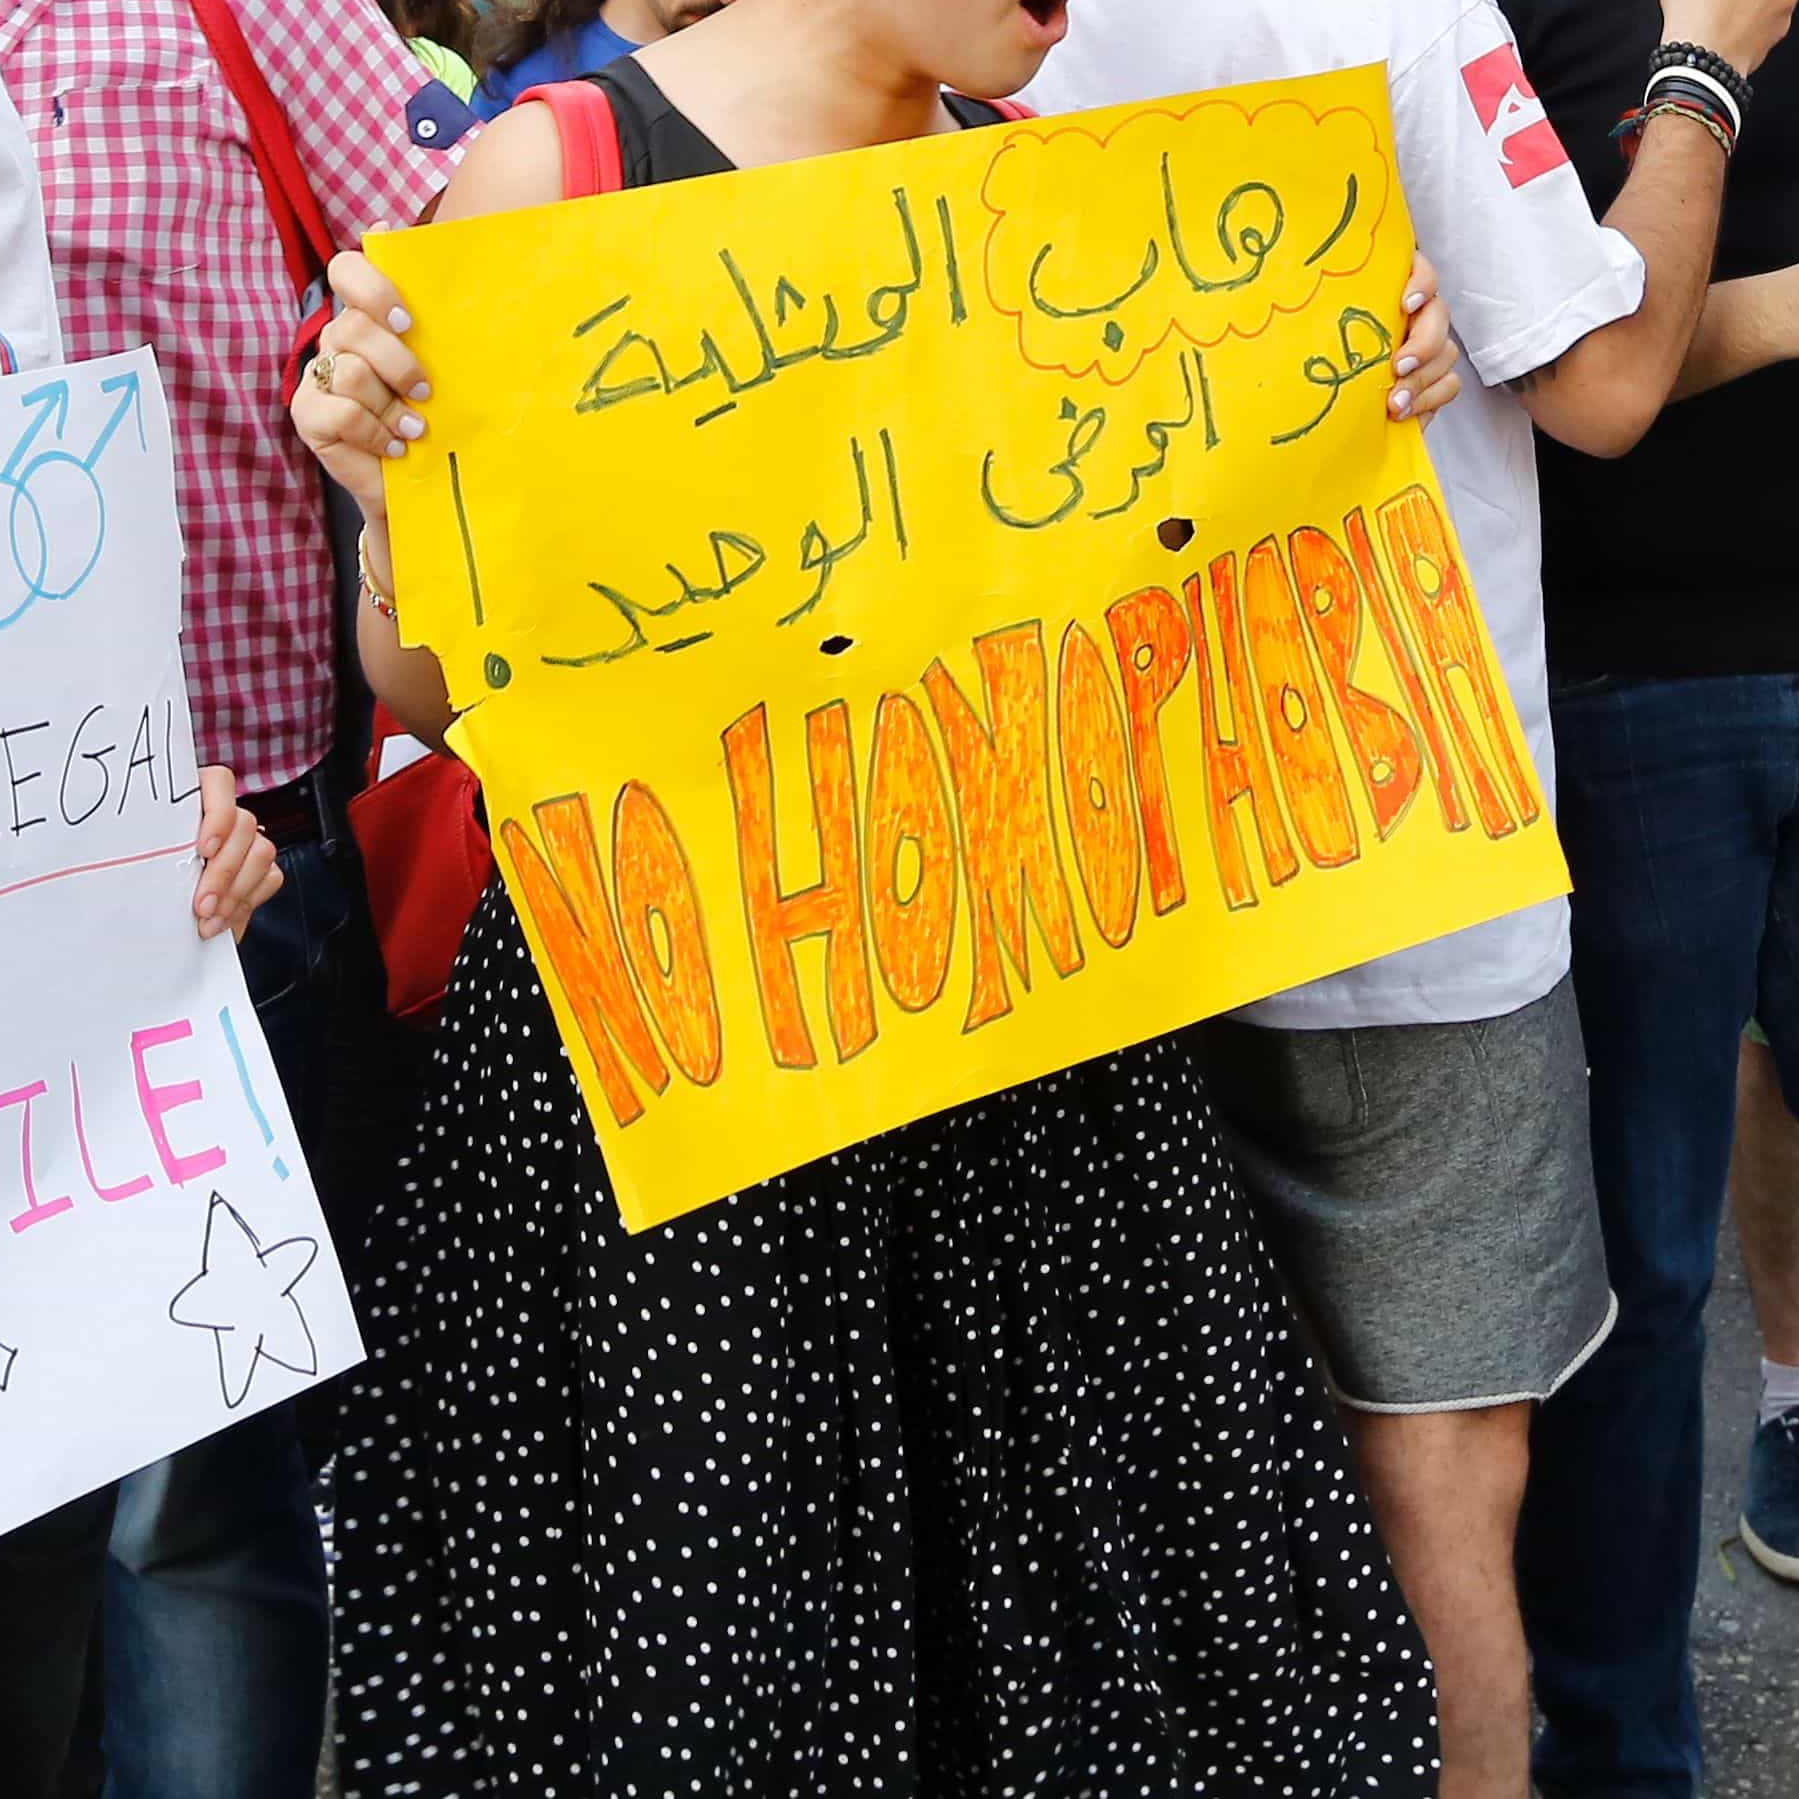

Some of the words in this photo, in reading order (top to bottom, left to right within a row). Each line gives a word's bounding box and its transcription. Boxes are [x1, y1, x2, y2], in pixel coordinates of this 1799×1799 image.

[1029, 151, 1358, 353] رهاب
[1269, 306, 1393, 446] هو
[539, 426, 910, 668] الوحيد
[502, 778, 724, 1130] NO
[722, 484, 1543, 1035] HOMOPHOBIA
